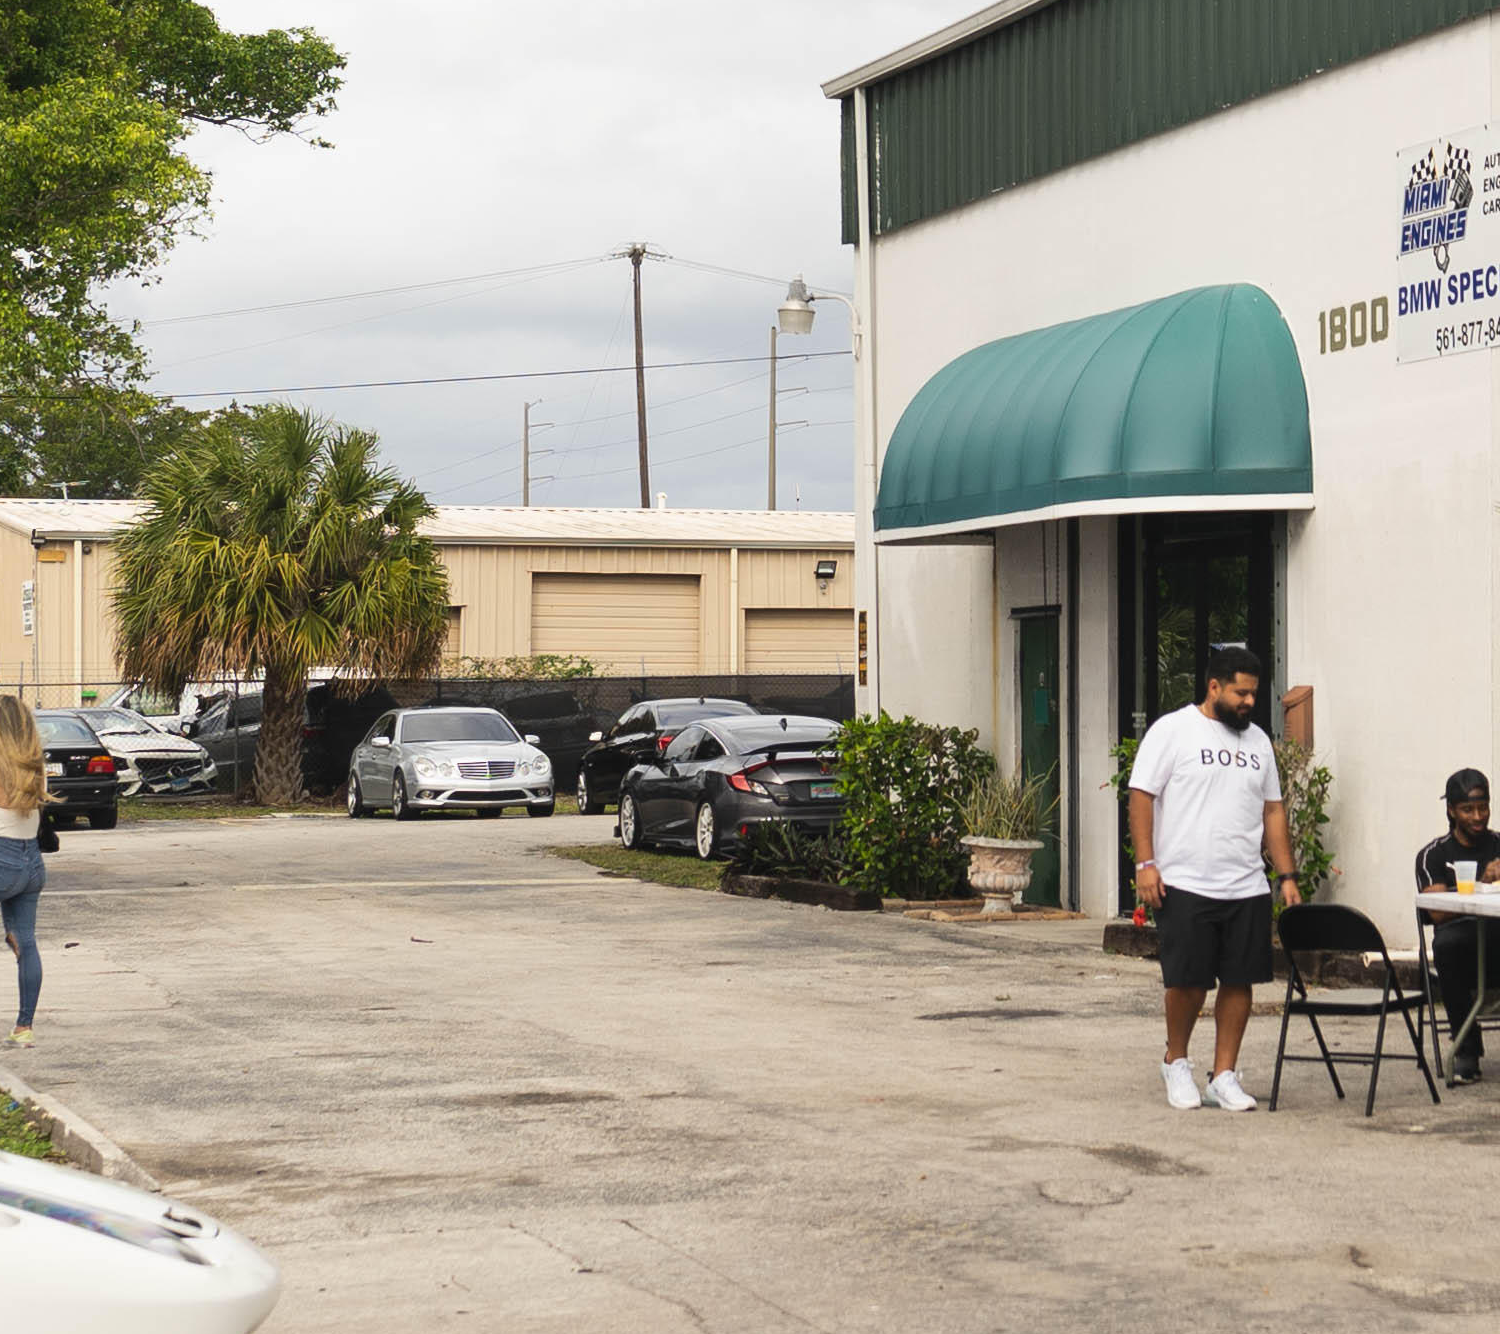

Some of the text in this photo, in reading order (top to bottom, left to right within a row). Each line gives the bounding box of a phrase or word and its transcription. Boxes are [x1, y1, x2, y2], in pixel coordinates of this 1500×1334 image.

[1403, 178, 1448, 216] MIAMI
[1401, 210, 1467, 253] ENGINES
[1398, 278, 1442, 316] BMW
[1318, 295, 1390, 355] 1800
[1201, 749, 1260, 770] BOSS
